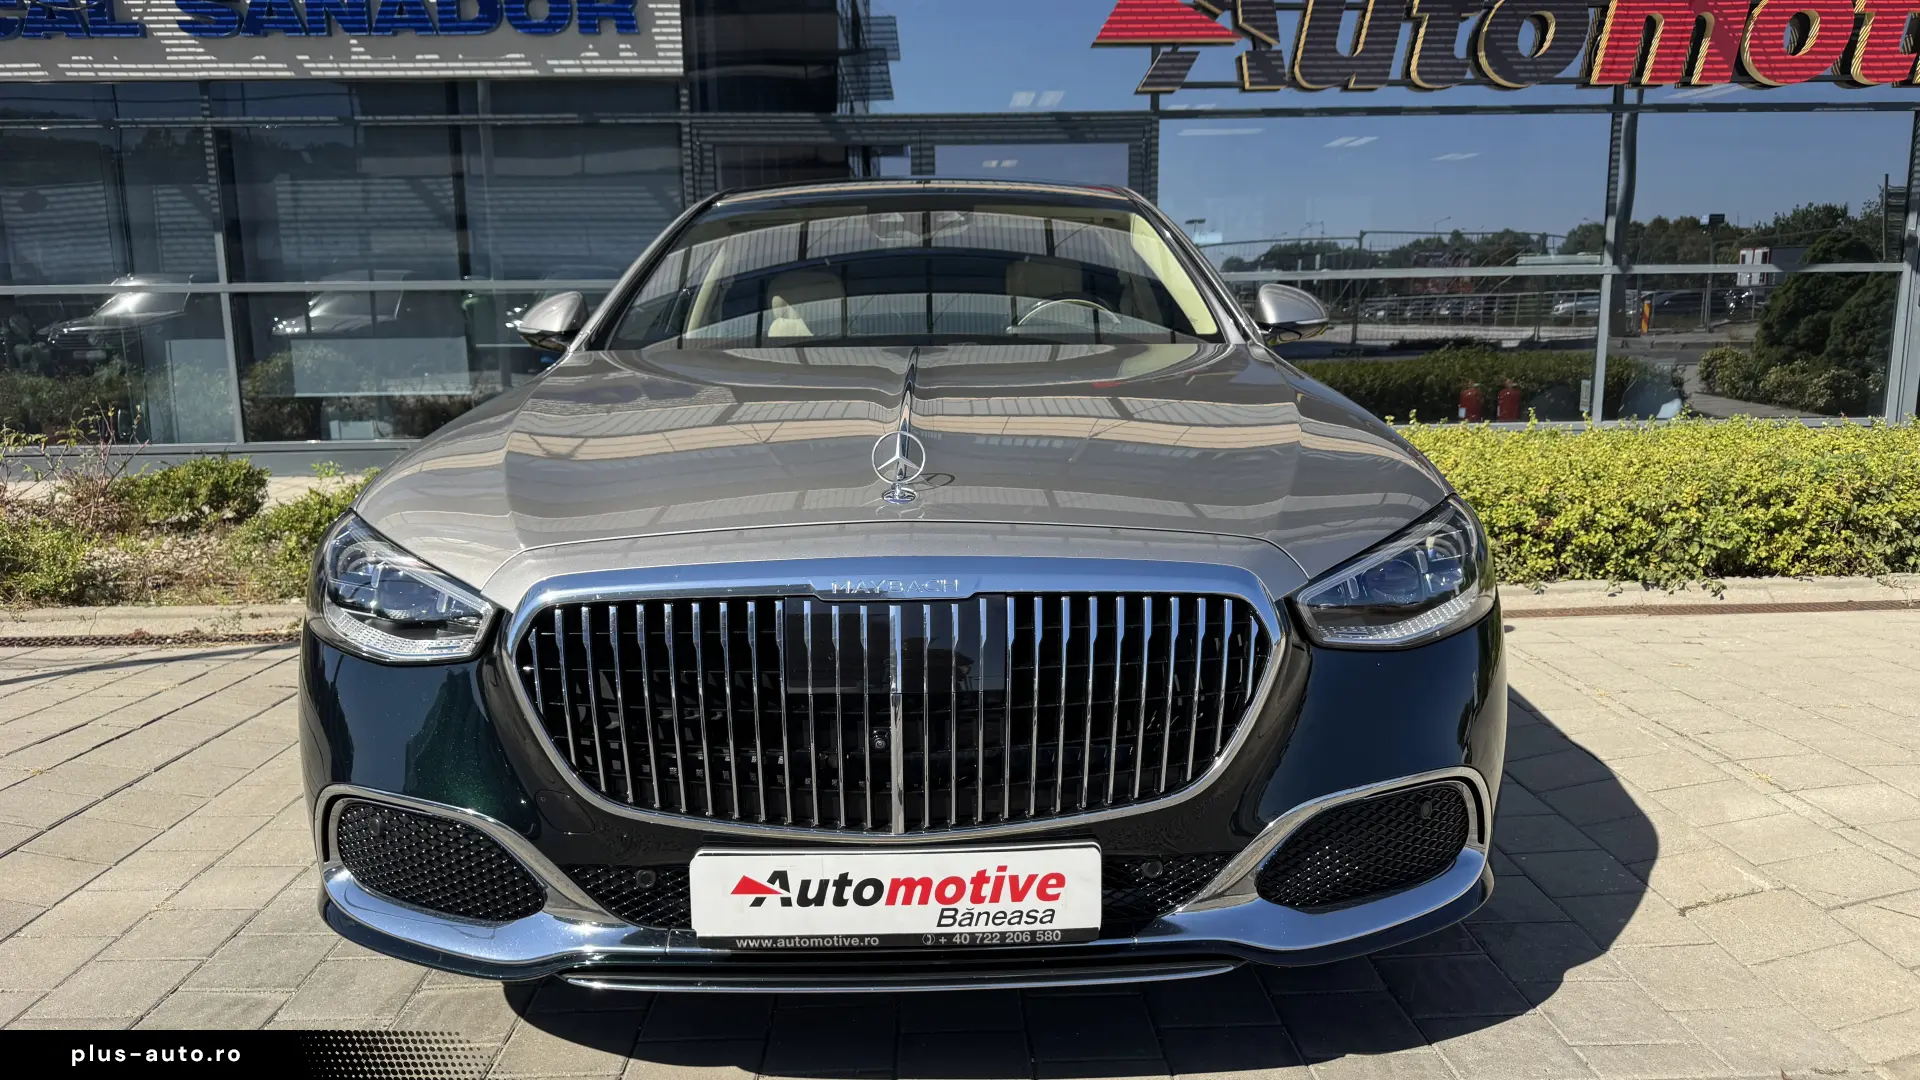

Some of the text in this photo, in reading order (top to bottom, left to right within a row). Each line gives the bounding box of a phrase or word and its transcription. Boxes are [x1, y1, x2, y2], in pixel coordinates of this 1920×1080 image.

[174, 0, 640, 37] SANADOR
[1135, 0, 1920, 90] Automot
[831, 579, 959, 594] MAYBACH
[748, 865, 1066, 907] Automotive
[936, 907, 1056, 928] Băneasa
[735, 935, 880, 948] www.automotive.ro
[952, 933, 970, 945] 40
[975, 932, 1001, 945] 722
[1005, 931, 1031, 944] 206
[1035, 930, 1062, 942] 580
